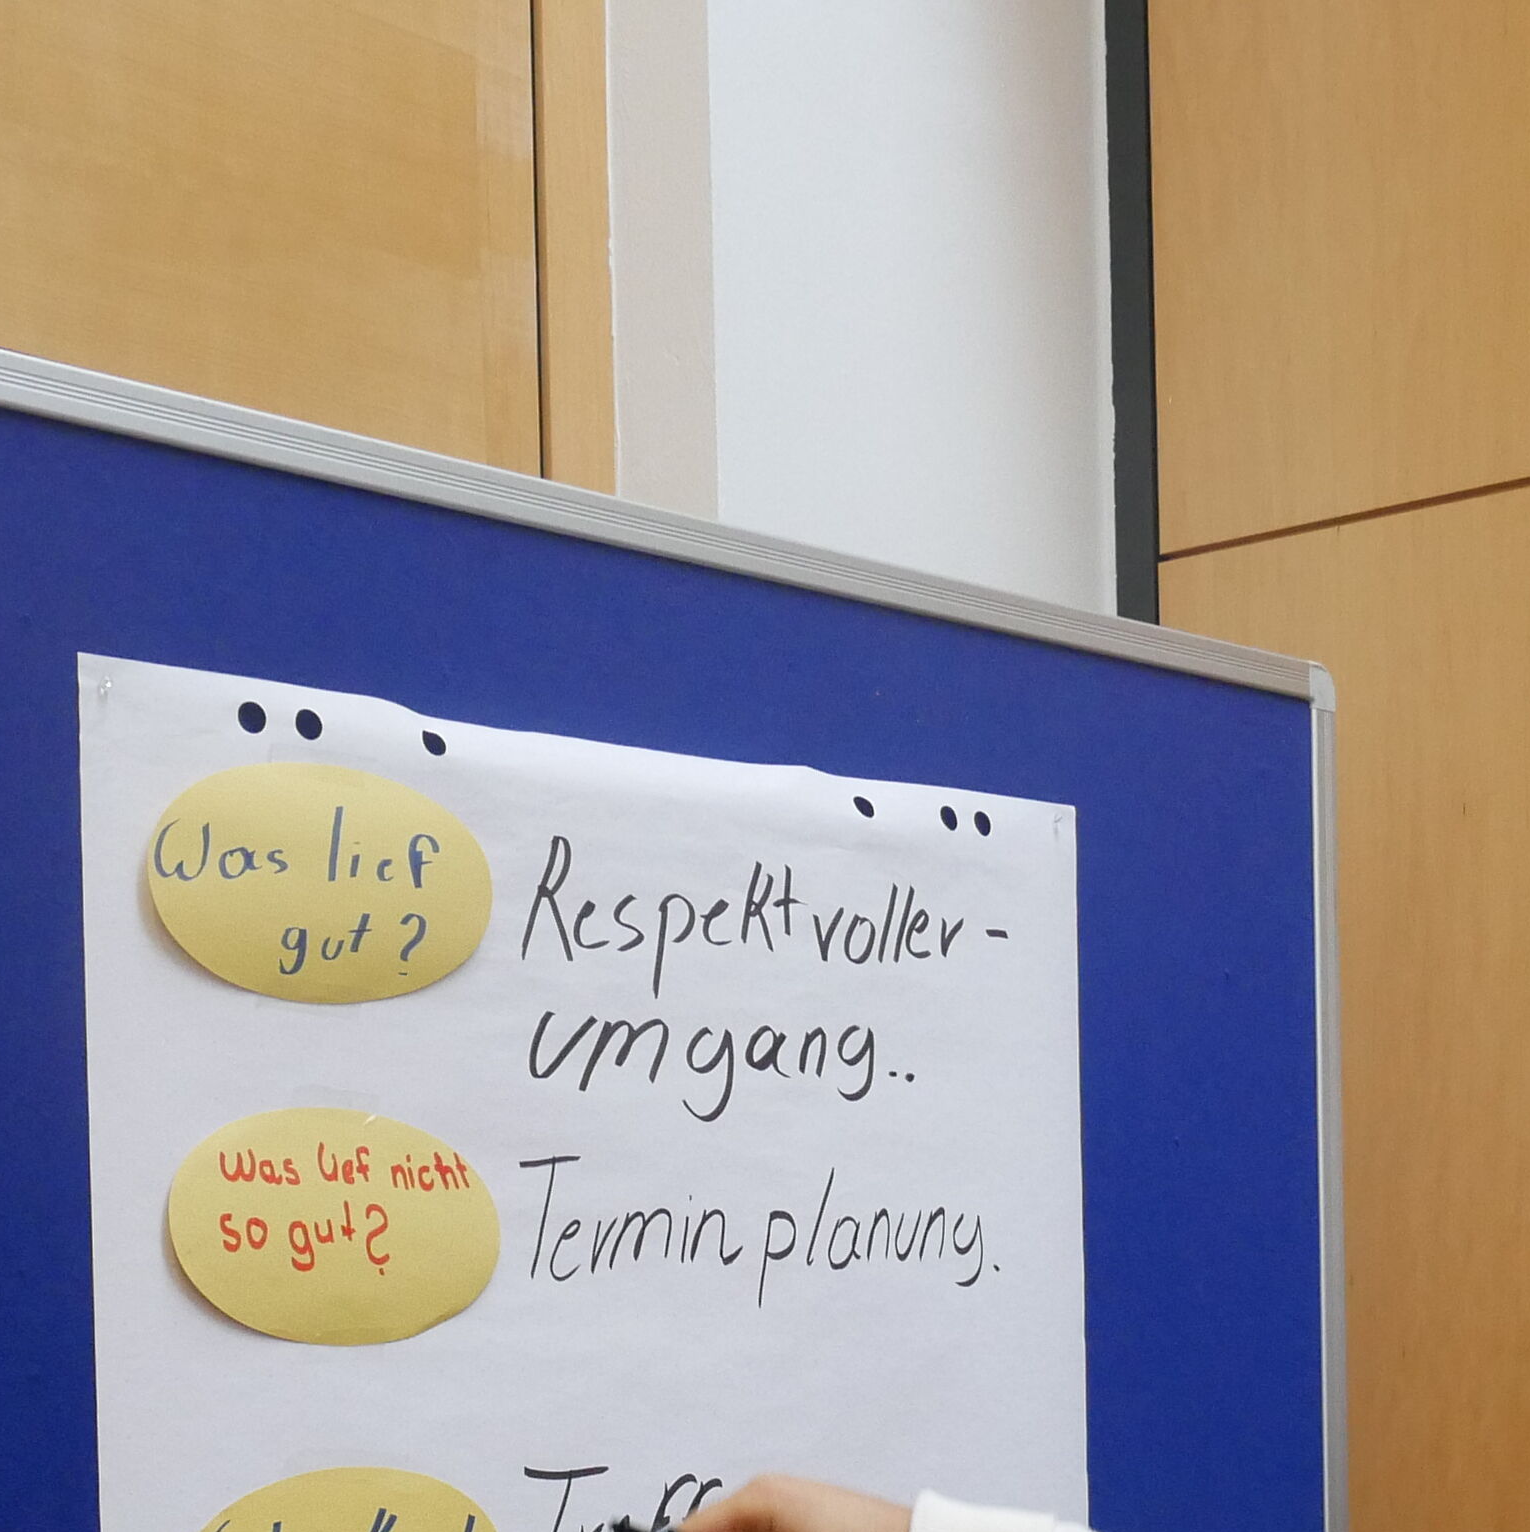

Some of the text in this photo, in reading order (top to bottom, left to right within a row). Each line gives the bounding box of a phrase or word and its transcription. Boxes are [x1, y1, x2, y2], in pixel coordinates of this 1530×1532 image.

[154, 806, 440, 888] Was lief
[219, 1148, 301, 1186] Was
[390, 1151, 470, 1192] nicht
[219, 1212, 268, 1252] so
